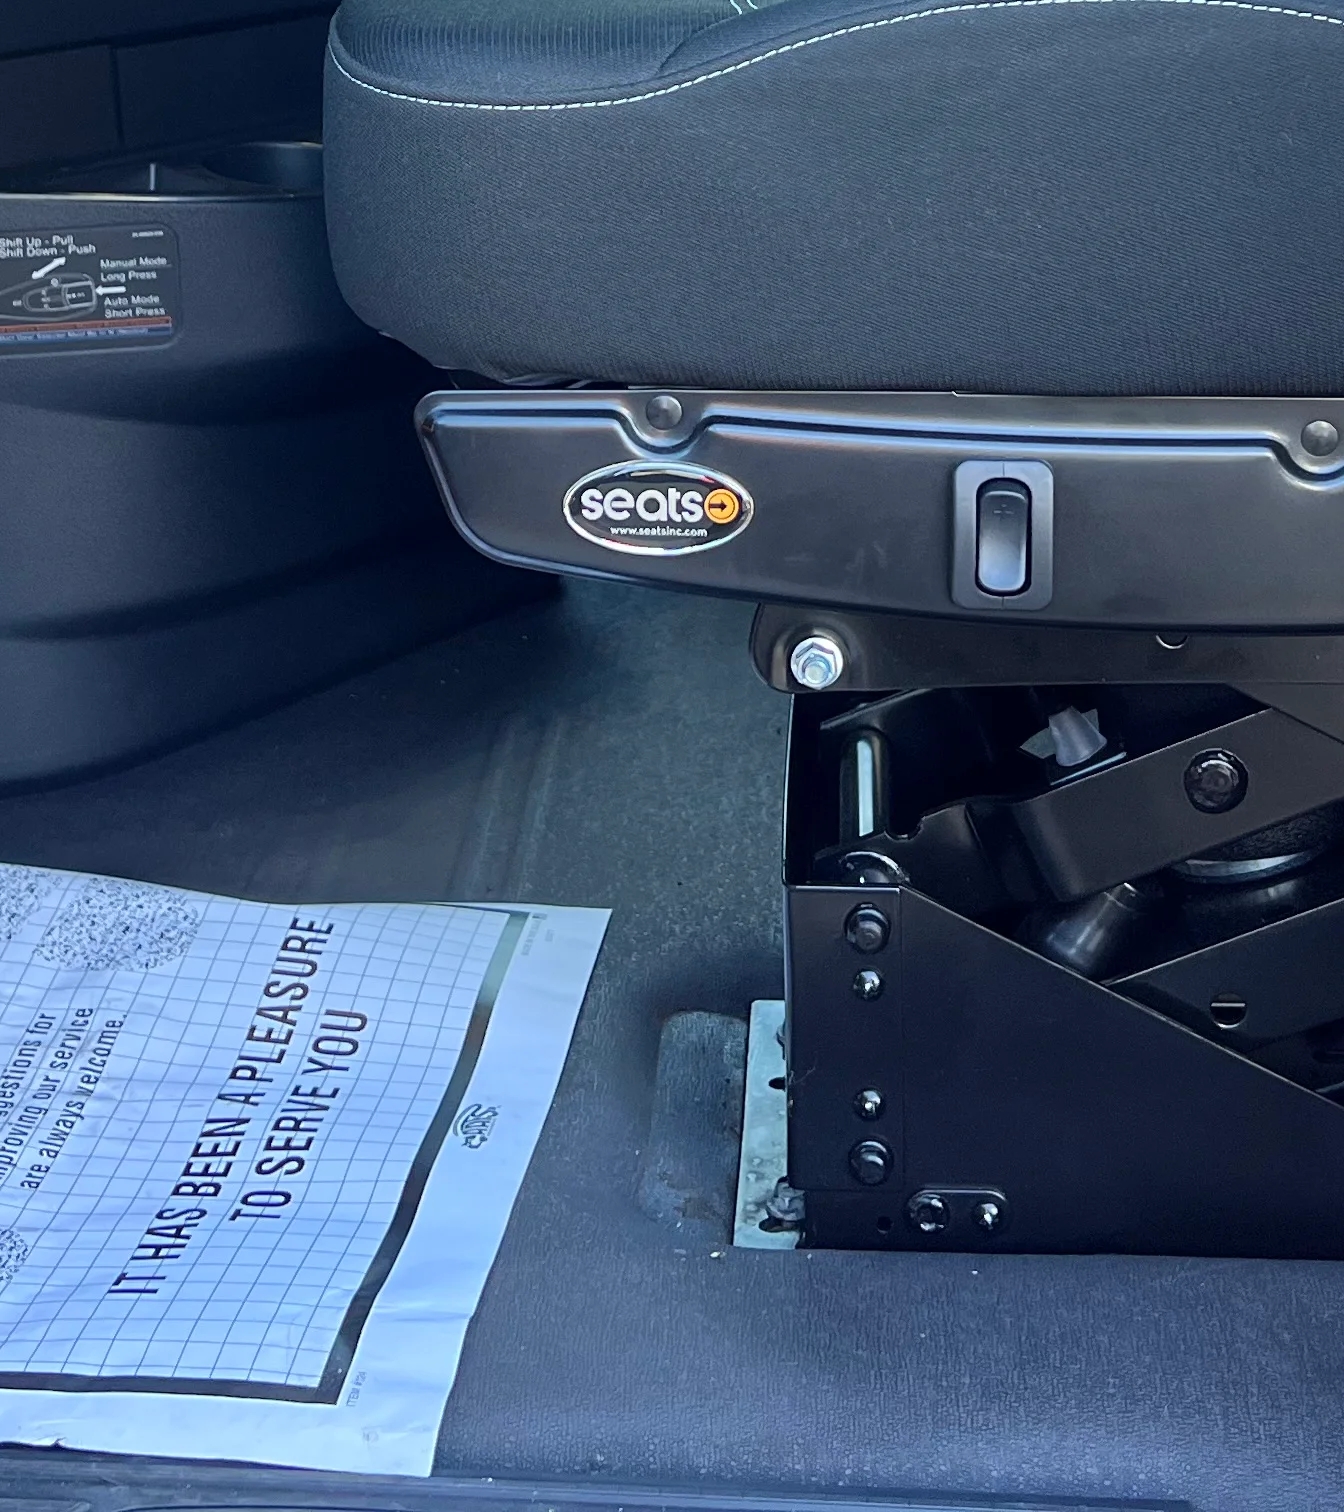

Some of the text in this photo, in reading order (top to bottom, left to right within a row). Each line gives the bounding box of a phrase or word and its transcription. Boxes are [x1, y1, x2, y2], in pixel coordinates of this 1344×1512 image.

[26, 237, 42, 249] Up
[53, 235, 74, 246] Pull
[27, 246, 58, 257] Down
[68, 244, 97, 255] Push
[100, 255, 168, 269] Manual Mode
[100, 270, 157, 284] Long Press
[104, 294, 161, 307] Auto Mode
[105, 305, 166, 318] Short Press
[581, 488, 704, 523] seats
[610, 526, 708, 538] www.seatsinc.com
[26, 1013, 56, 1035] for
[32, 1075, 61, 1100] our
[49, 1008, 94, 1071] service
[20, 1014, 128, 1189] are always welcome.
[107, 917, 334, 1294] IT HAS BEEN A PLEASURE
[229, 1008, 369, 1221] TO SERVE YOU
